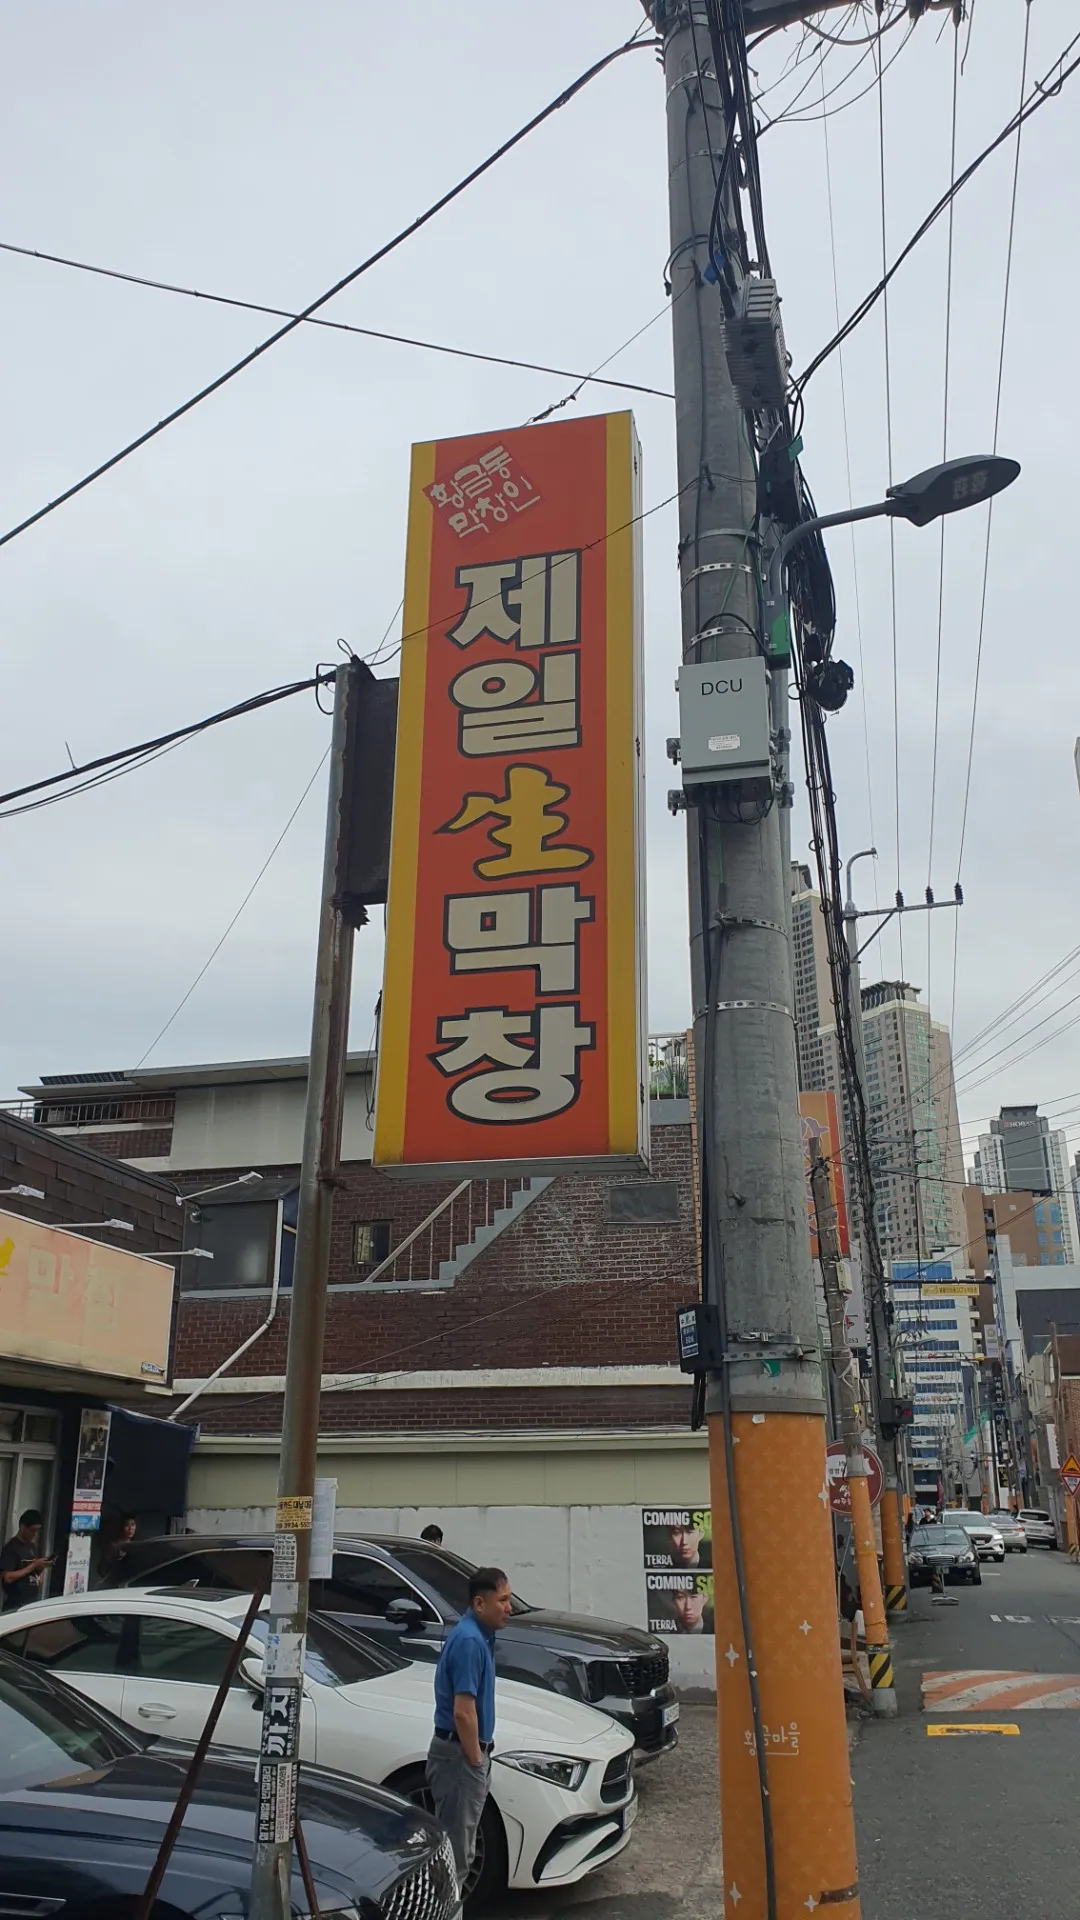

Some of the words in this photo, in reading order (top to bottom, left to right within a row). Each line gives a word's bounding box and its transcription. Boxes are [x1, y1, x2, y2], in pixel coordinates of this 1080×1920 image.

[430, 445, 513, 509] 황금동
[448, 475, 541, 538] 막창인
[701, 678, 743, 696] DCU
[643, 1511, 690, 1526] COMING
[645, 1554, 673, 1566] TERRA
[647, 1575, 694, 1590] COMING
[650, 1619, 678, 1631] TERRA
